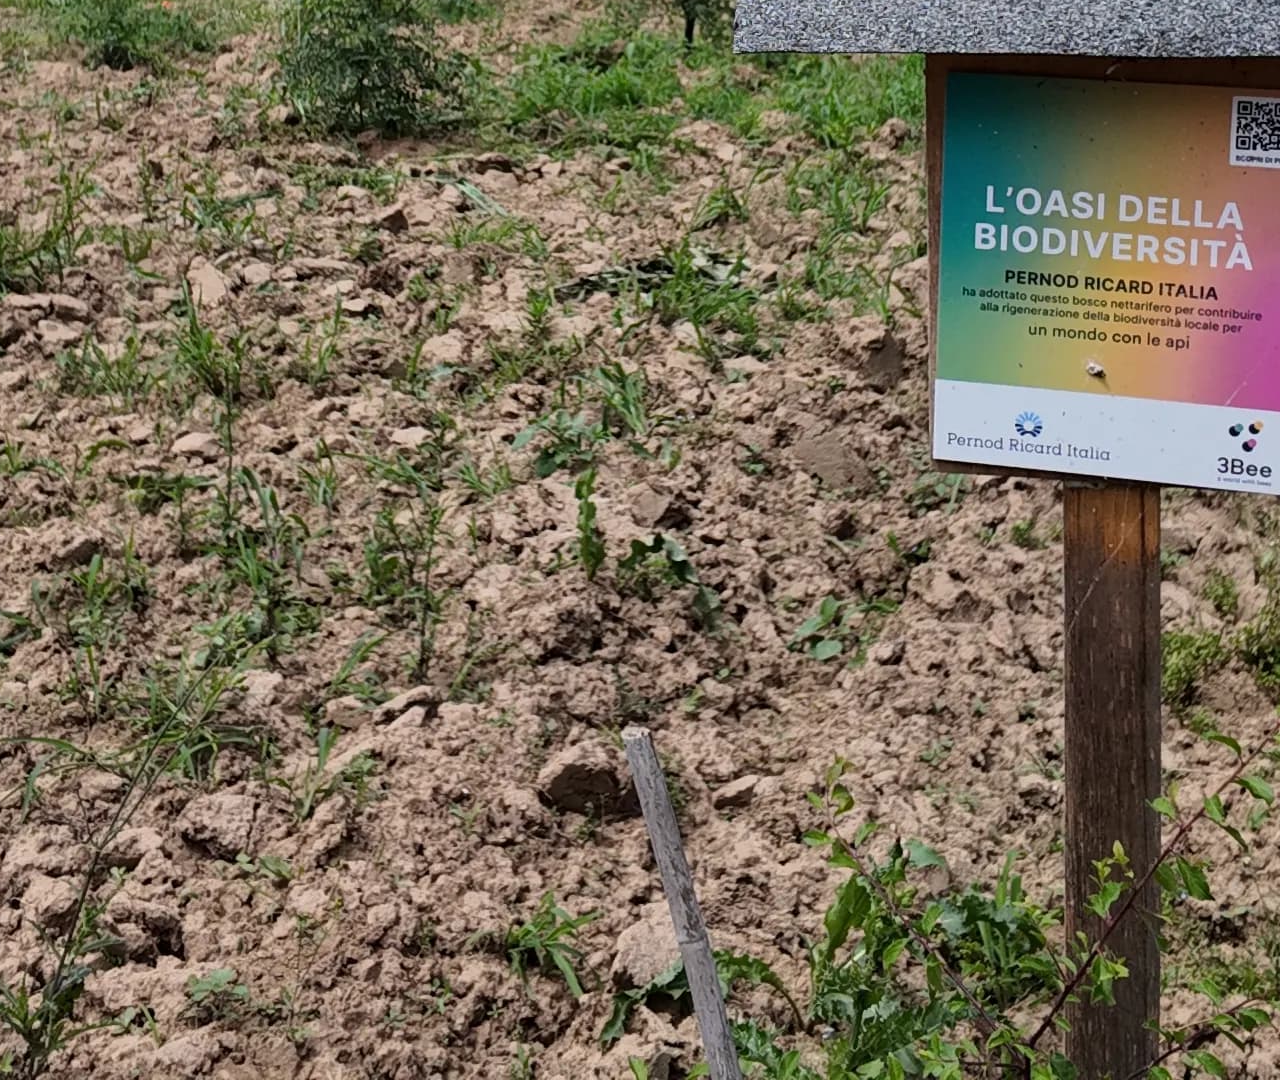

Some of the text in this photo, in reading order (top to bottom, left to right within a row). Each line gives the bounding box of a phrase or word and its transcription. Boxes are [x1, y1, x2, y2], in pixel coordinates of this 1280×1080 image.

[1119, 194, 1244, 231] DELLA
[974, 223, 1253, 271] BIODIVERSITÀ
[1005, 270, 1218, 300] PERNOD RICARD ITALIA
[962, 286, 1263, 321] ha adottato questo bosco nettarifero per contribuire
[980, 302, 1243, 334] alla rigenerazione della biodiversità locale per
[1028, 325, 1190, 351] un mondo con le api
[947, 432, 1111, 461] Pernod Ricard Italia
[1217, 456, 1272, 478] 3Bee
